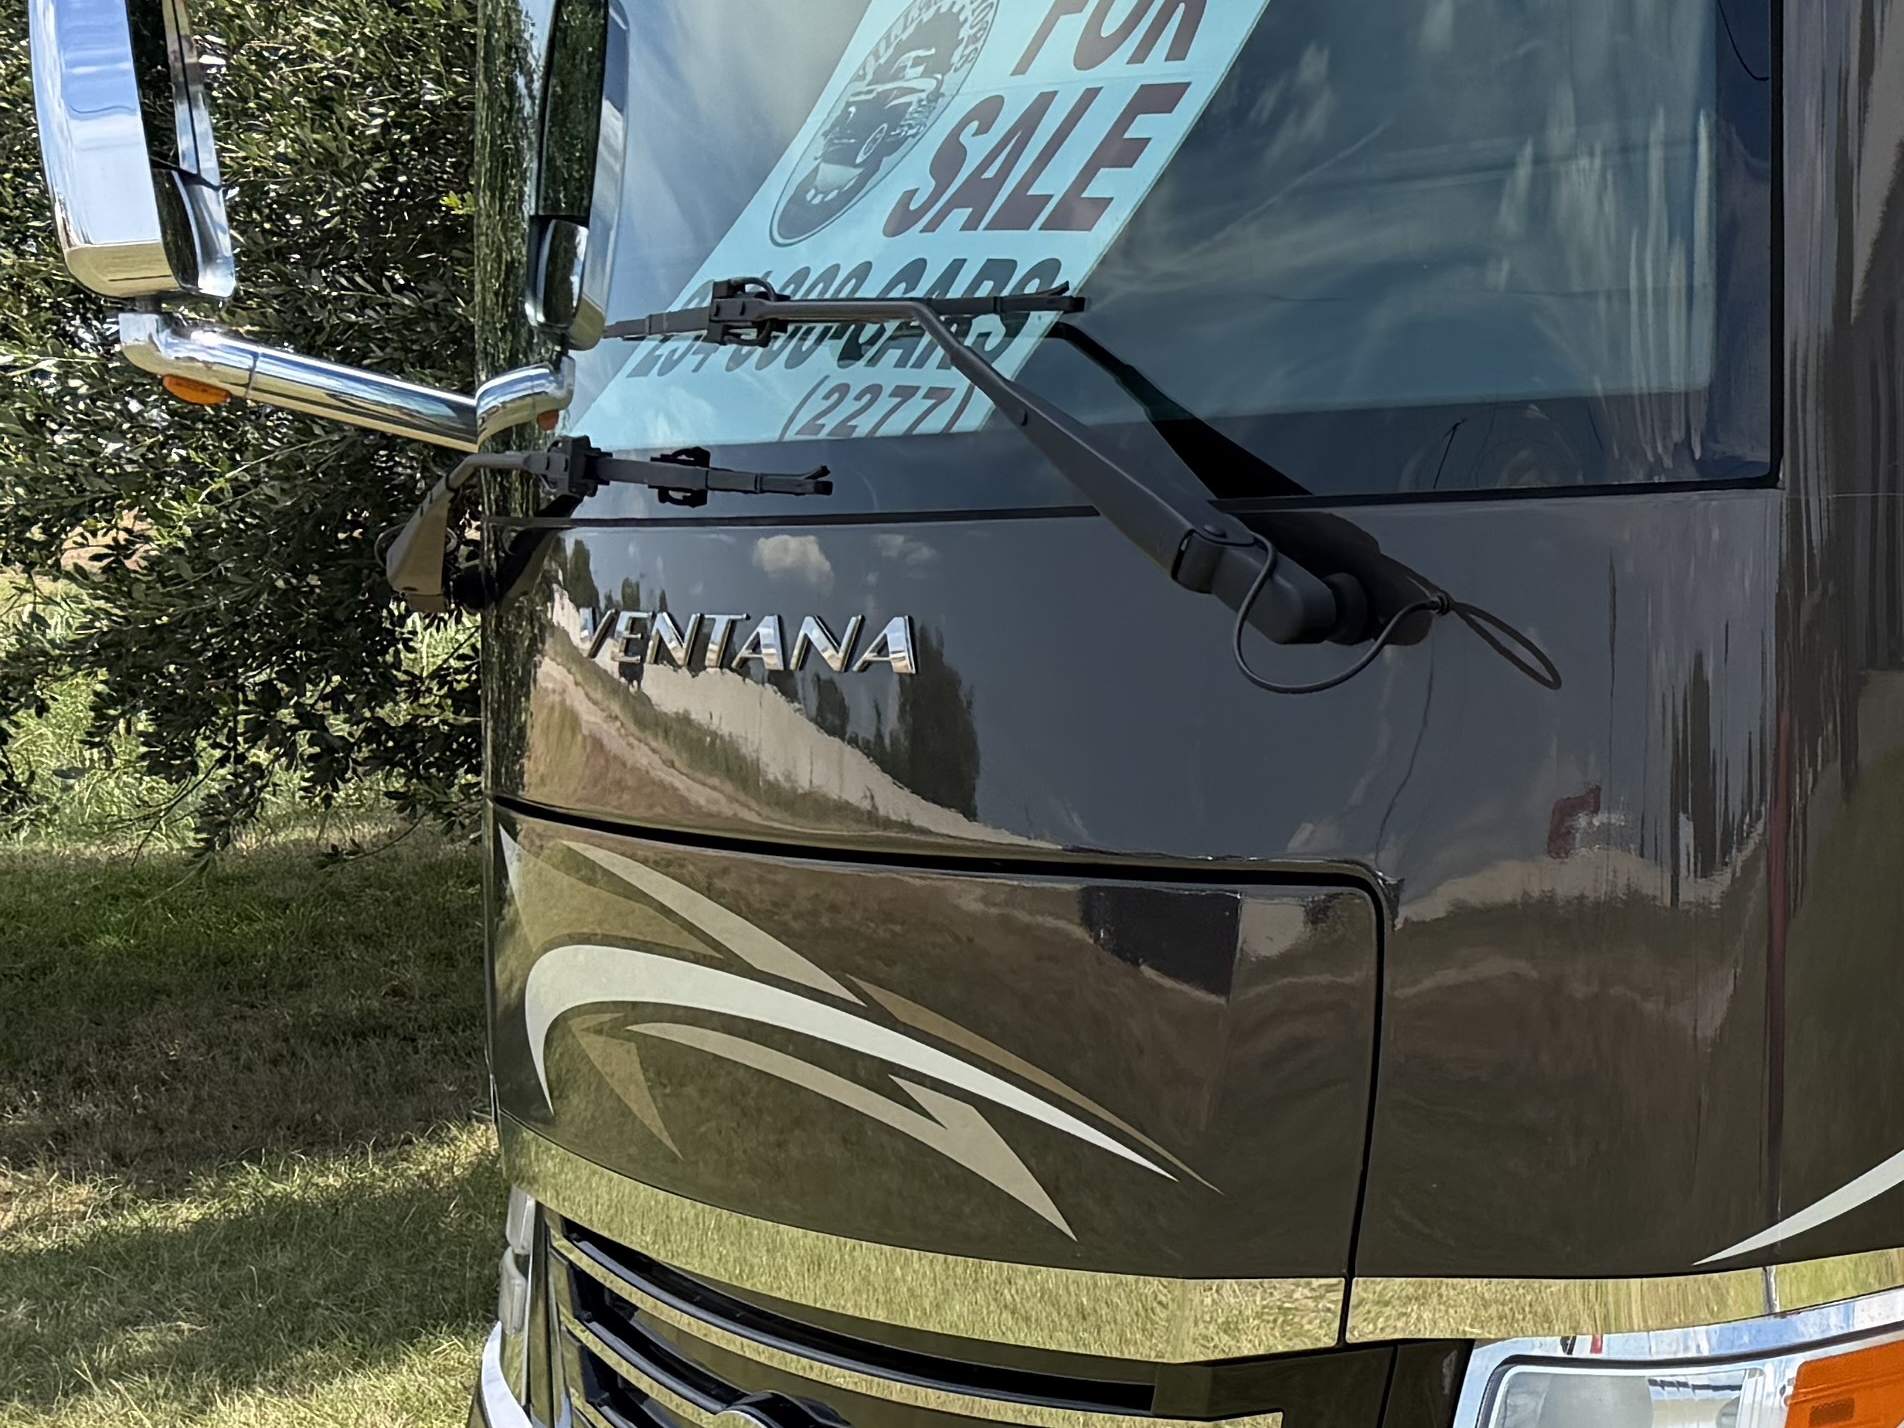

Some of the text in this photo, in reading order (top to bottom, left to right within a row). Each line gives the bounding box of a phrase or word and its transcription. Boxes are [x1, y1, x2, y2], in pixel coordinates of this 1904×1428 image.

[881, 80, 1191, 239] SALE
[777, 374, 977, 442] (2277)
[578, 606, 919, 676] VENTANA
